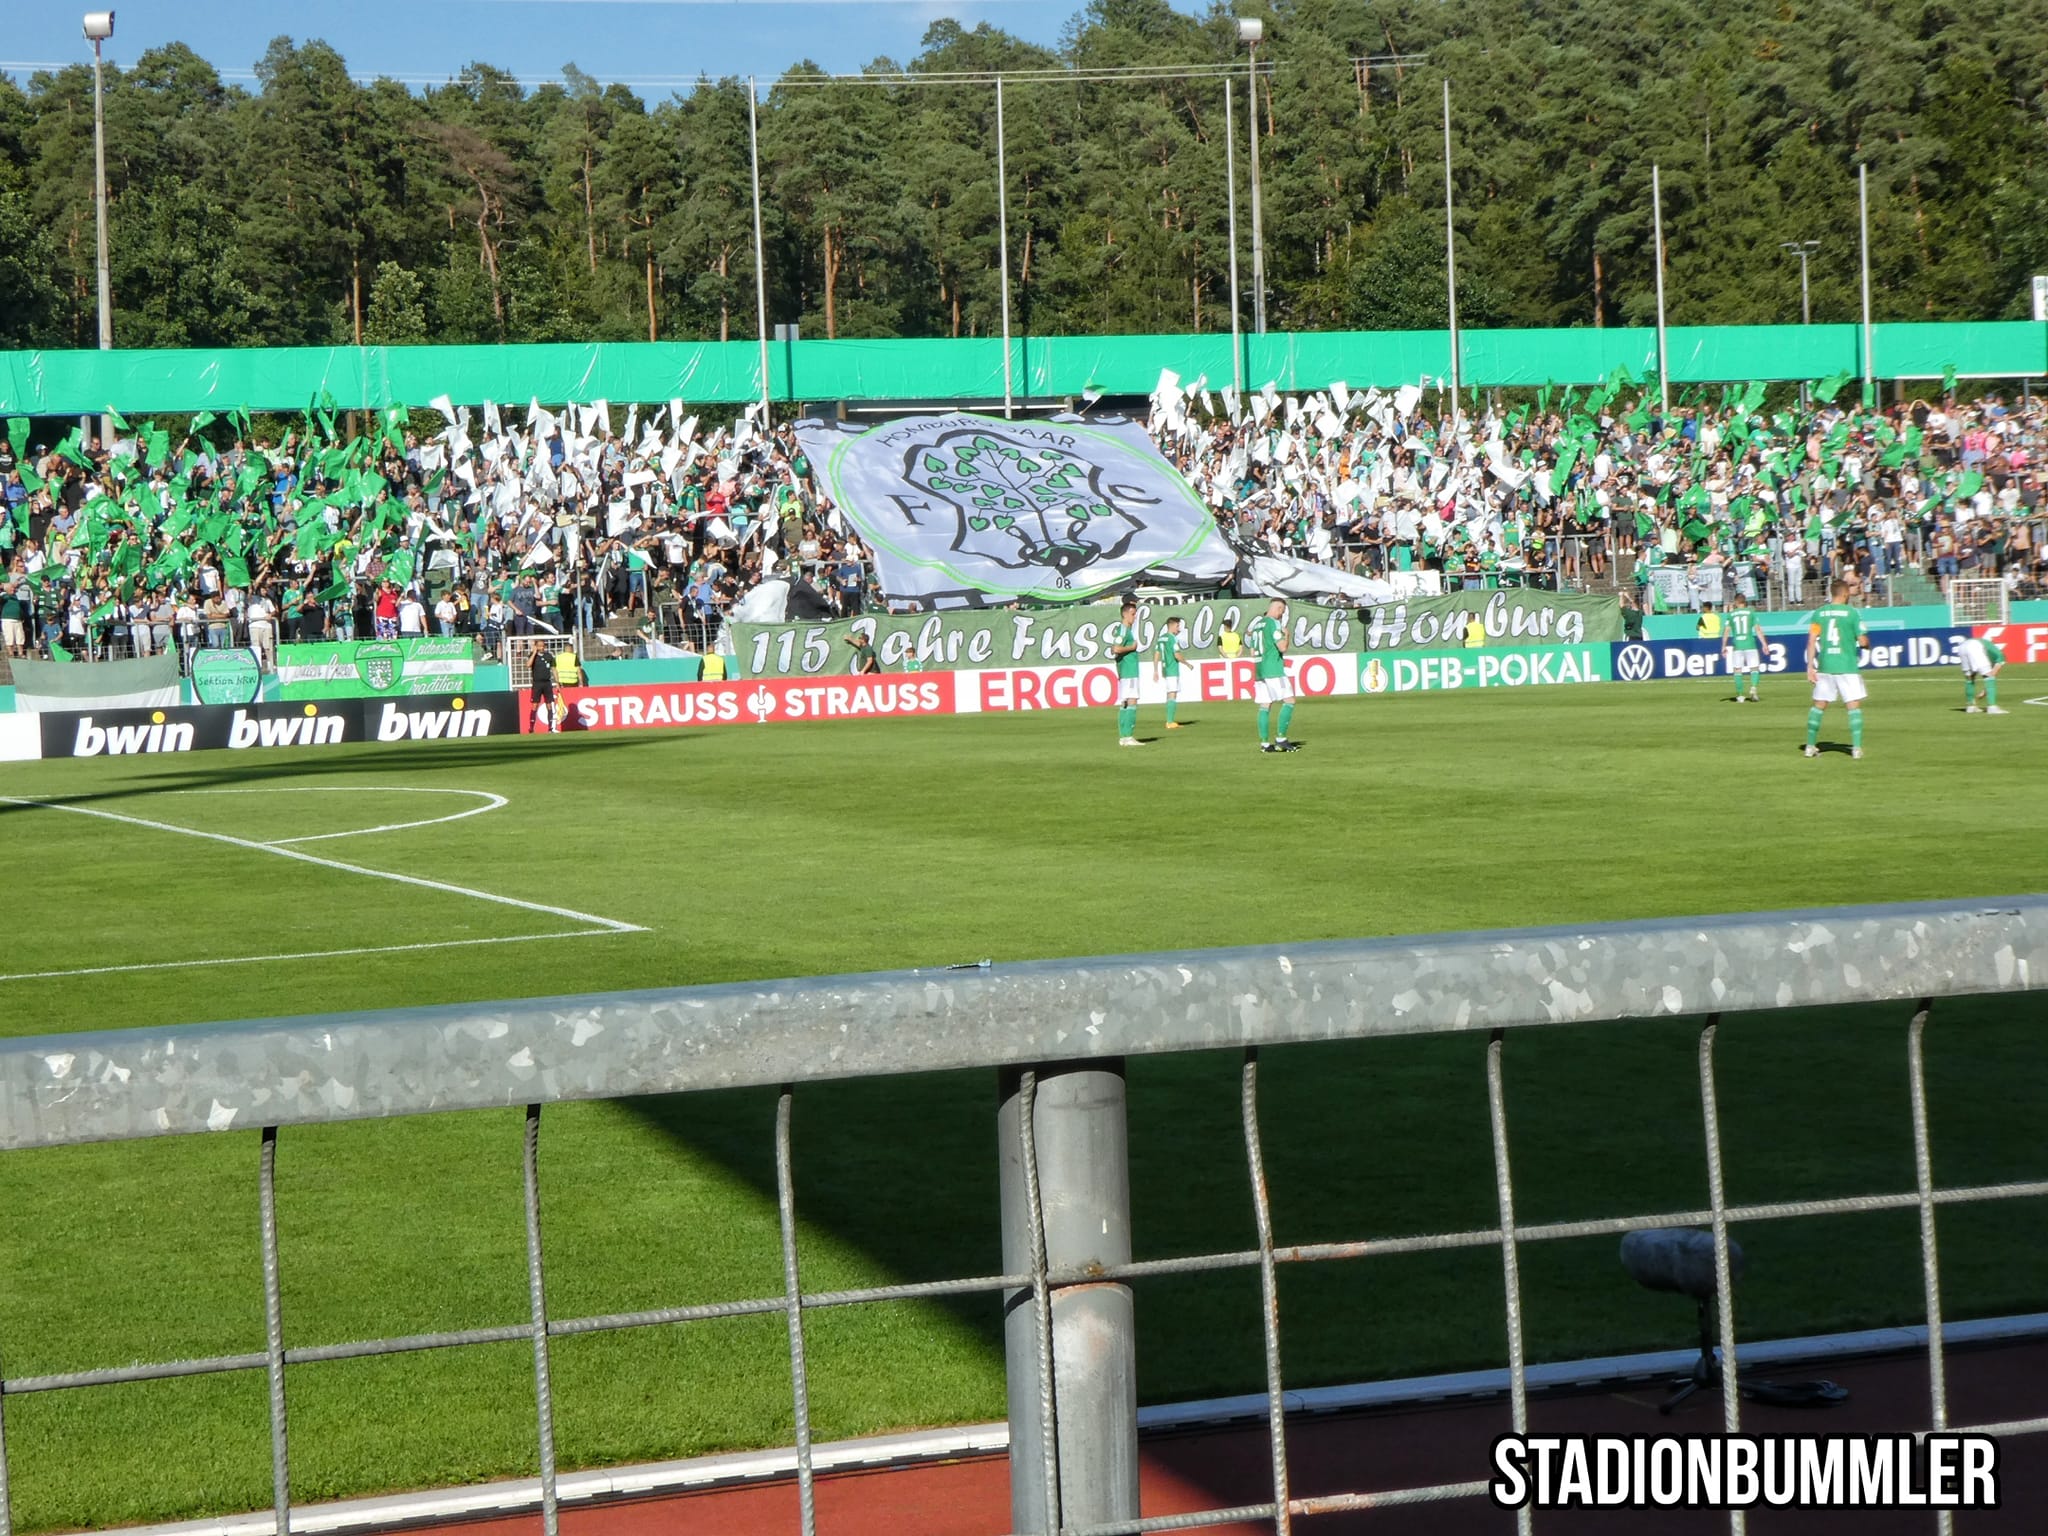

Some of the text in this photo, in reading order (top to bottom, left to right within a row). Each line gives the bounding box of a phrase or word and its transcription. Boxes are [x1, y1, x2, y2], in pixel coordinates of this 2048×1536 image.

[885, 484, 1163, 526] F C
[751, 627, 832, 674] 115
[850, 614, 992, 675] Jahre
[1367, 591, 1585, 649] Homburg
[1733, 615, 1748, 635] 11
[1827, 618, 1840, 646] 4
[1393, 650, 1601, 692] DFB-POKAL
[1664, 648, 1720, 677] Der
[1726, 643, 1788, 677] I.3
[578, 682, 941, 727] STRAUSS STRAUSS
[979, 667, 1118, 712] ERGO
[73, 697, 492, 757] bwin bwin bwin
